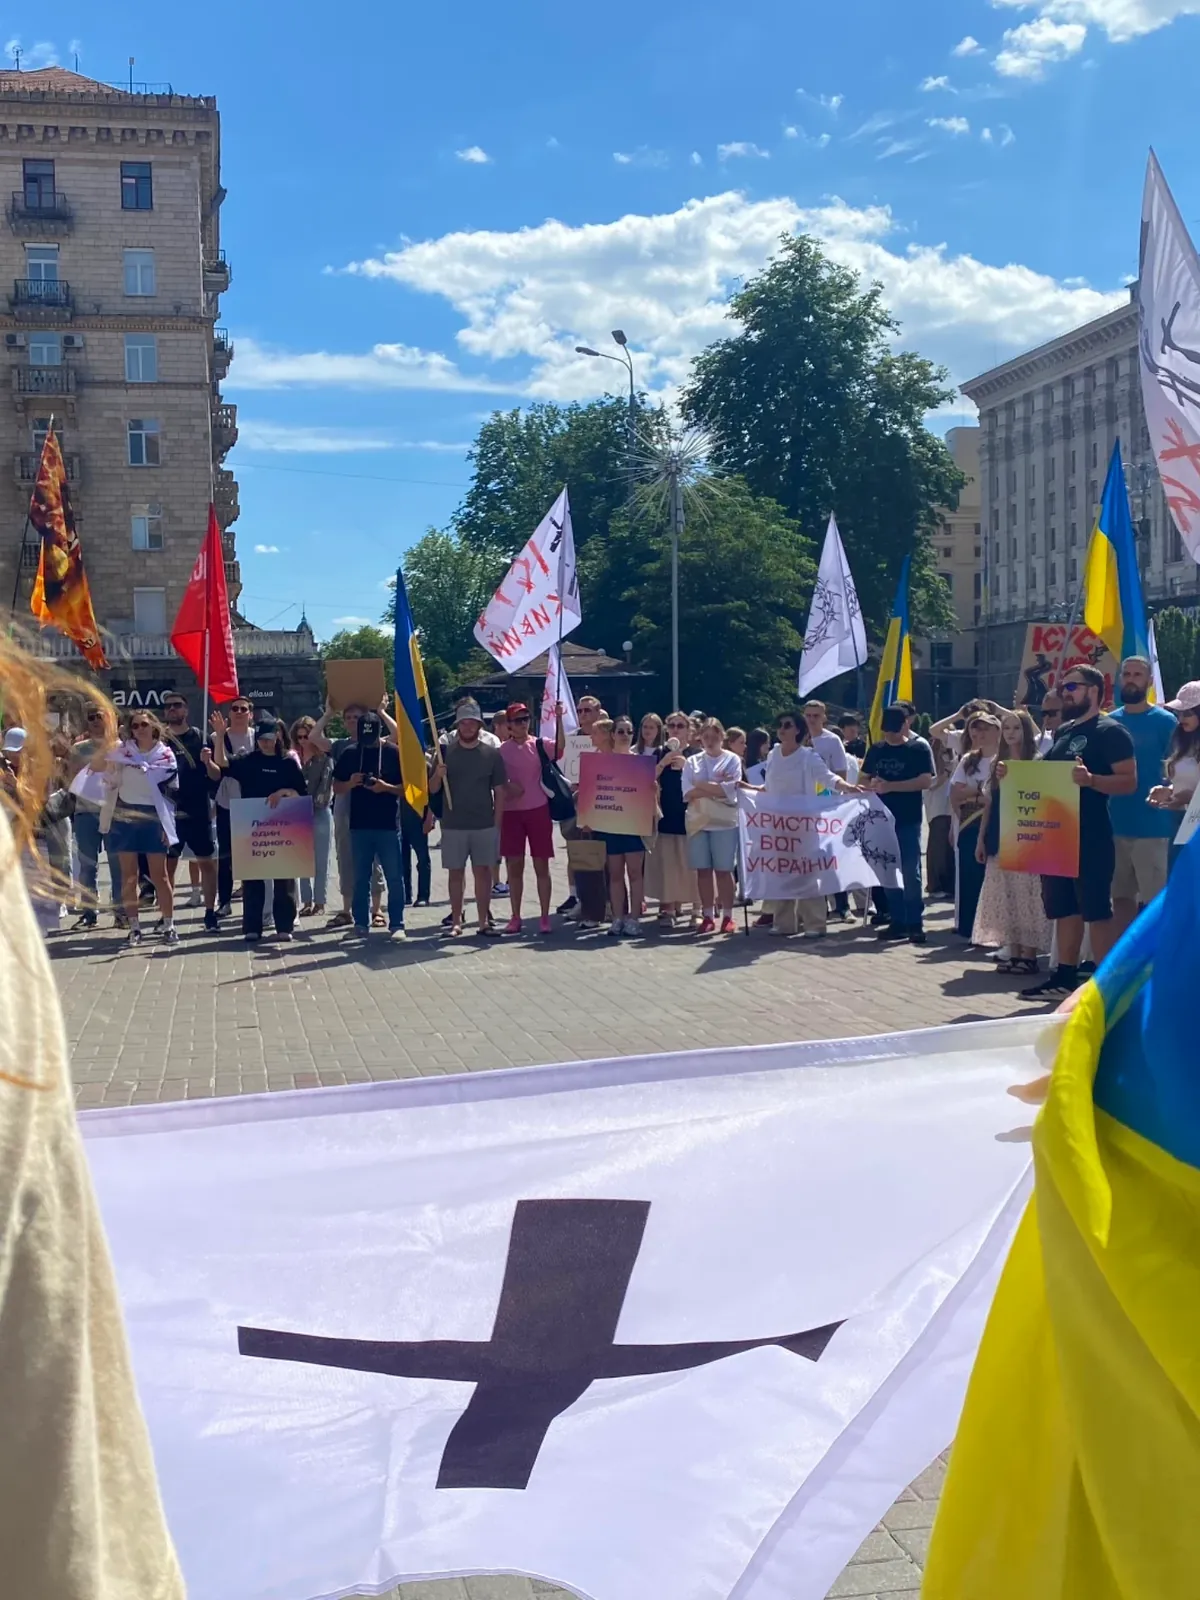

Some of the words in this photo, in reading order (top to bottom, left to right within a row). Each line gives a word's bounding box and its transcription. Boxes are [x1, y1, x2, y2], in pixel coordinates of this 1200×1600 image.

[1017, 790, 1041, 800] Тобі
[1017, 807, 1036, 815] тут
[746, 812, 843, 834] ХРИСТОС
[1017, 819, 1061, 828] завжди
[252, 830, 281, 838] один
[252, 839, 295, 847] одного.
[761, 835, 803, 853] БОГ
[252, 849, 276, 858] Ісус
[747, 855, 838, 875] УКРАЇНИ
